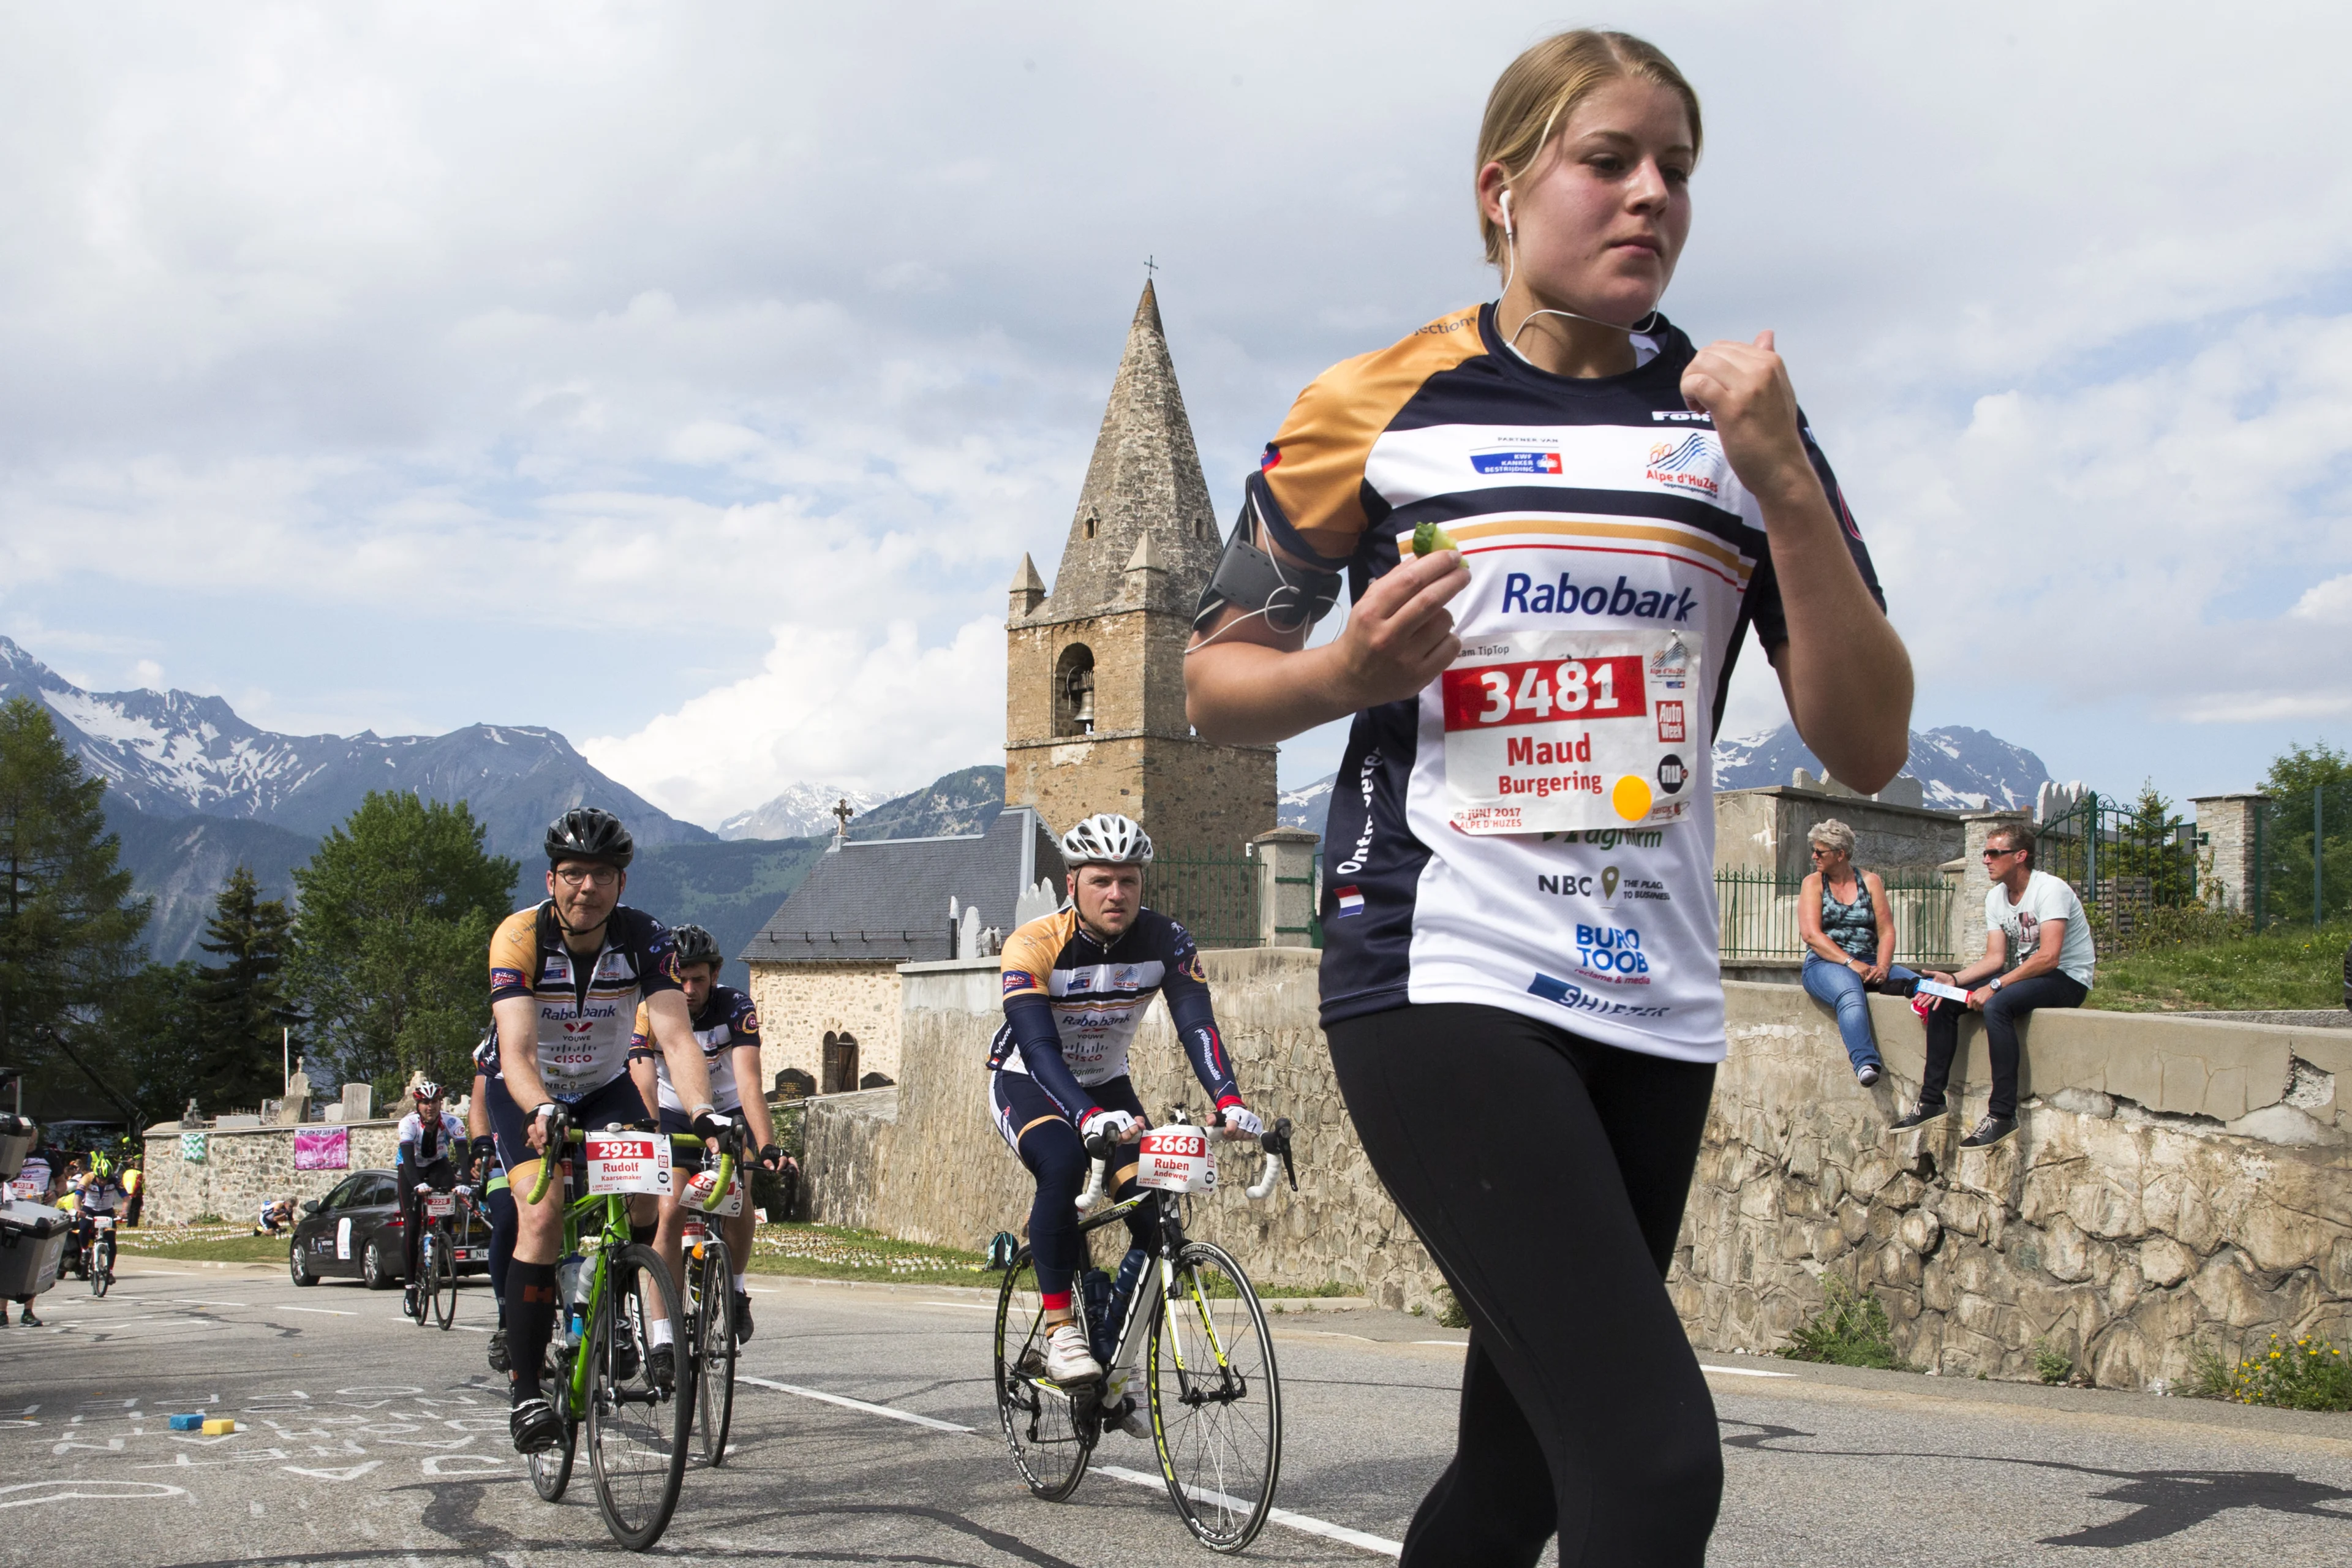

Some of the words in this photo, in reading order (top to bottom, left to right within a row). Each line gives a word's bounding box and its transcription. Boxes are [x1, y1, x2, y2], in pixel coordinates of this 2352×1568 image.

[1646, 469, 1673, 483] Alpe
[1677, 472, 1719, 493] d'HuZes
[1477, 645, 1510, 657] TipTop
[1479, 661, 1619, 723] 3481
[1659, 704, 1682, 723] Auto
[1660, 723, 1683, 739] Week
[1507, 732, 1592, 766] Maud
[1499, 770, 1603, 798] Burgering
[1468, 809, 1491, 821] JUNI
[1494, 807, 1521, 817] 2017
[1460, 820, 1481, 829] ALPE
[1483, 818, 1522, 828] D'HUZES
[1538, 874, 1593, 897] NBC
[1624, 891, 1632, 900] TO
[1576, 924, 1640, 950] BURO
[1576, 946, 1649, 974] TOOB
[1574, 968, 1613, 984] reclame
[1615, 976, 1623, 985] &
[1624, 975, 1651, 985] media
[541, 1005, 617, 1021] Rabobank
[1062, 1014, 1132, 1027] Rabobank
[554, 1054, 593, 1063] CISCO
[1067, 1053, 1102, 1063] CISCO
[1071, 1067, 1104, 1077] agrifirm
[545, 1082, 567, 1090] NBC
[556, 1091, 585, 1101] BURO
[598, 1142, 644, 1159] 2921
[1150, 1136, 1199, 1155] 2668
[603, 1162, 639, 1172] Rudolf
[1154, 1158, 1189, 1171] Ruben
[1154, 1170, 1188, 1182] Andeweg
[1099, 1204, 1133, 1222] PELOTON
[132, 1436, 493, 1469] ANET
